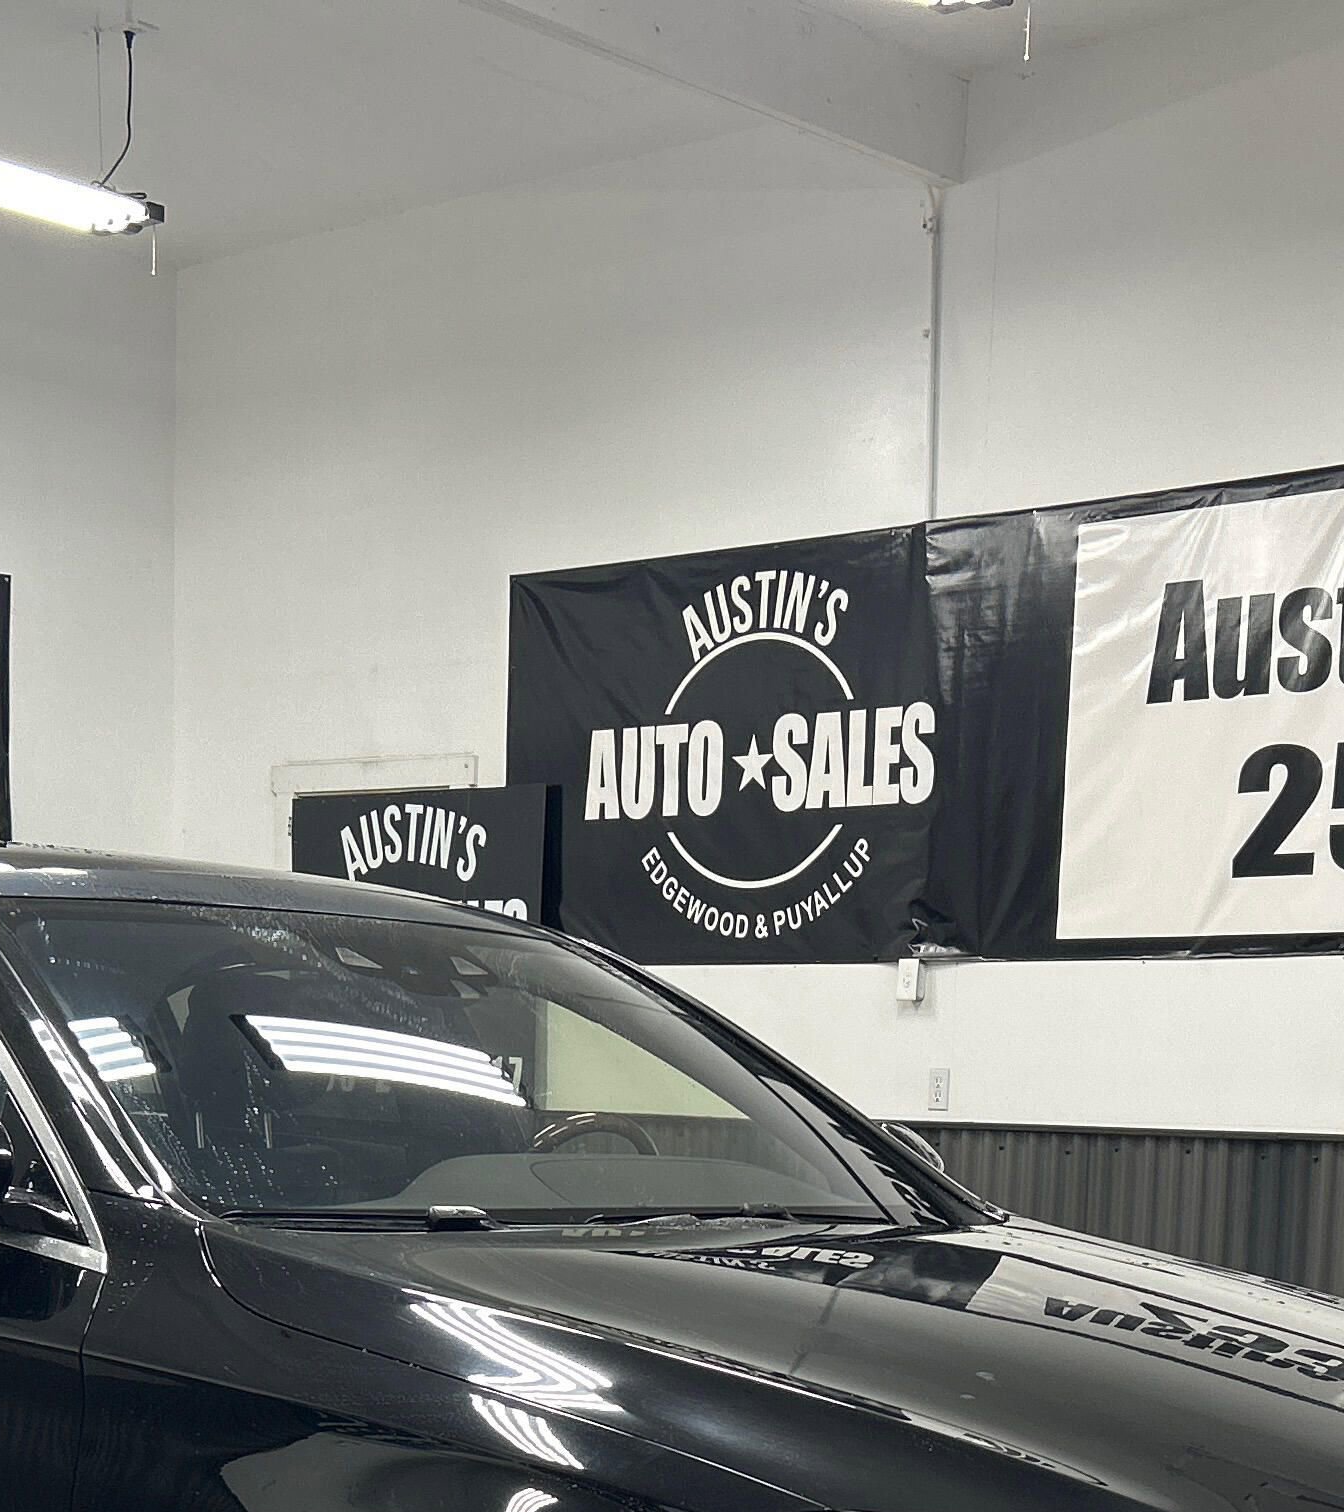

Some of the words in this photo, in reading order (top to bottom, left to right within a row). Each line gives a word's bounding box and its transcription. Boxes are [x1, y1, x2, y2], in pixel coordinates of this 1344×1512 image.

[682, 569, 849, 661] AUSTIN'S
[584, 719, 722, 821] AUTO
[771, 701, 935, 812] SALES
[340, 802, 487, 882] AUSTIN'S
[641, 846, 750, 940] EDGEWOOD
[754, 914, 769, 939] &
[773, 837, 873, 931] PUYALLUP
